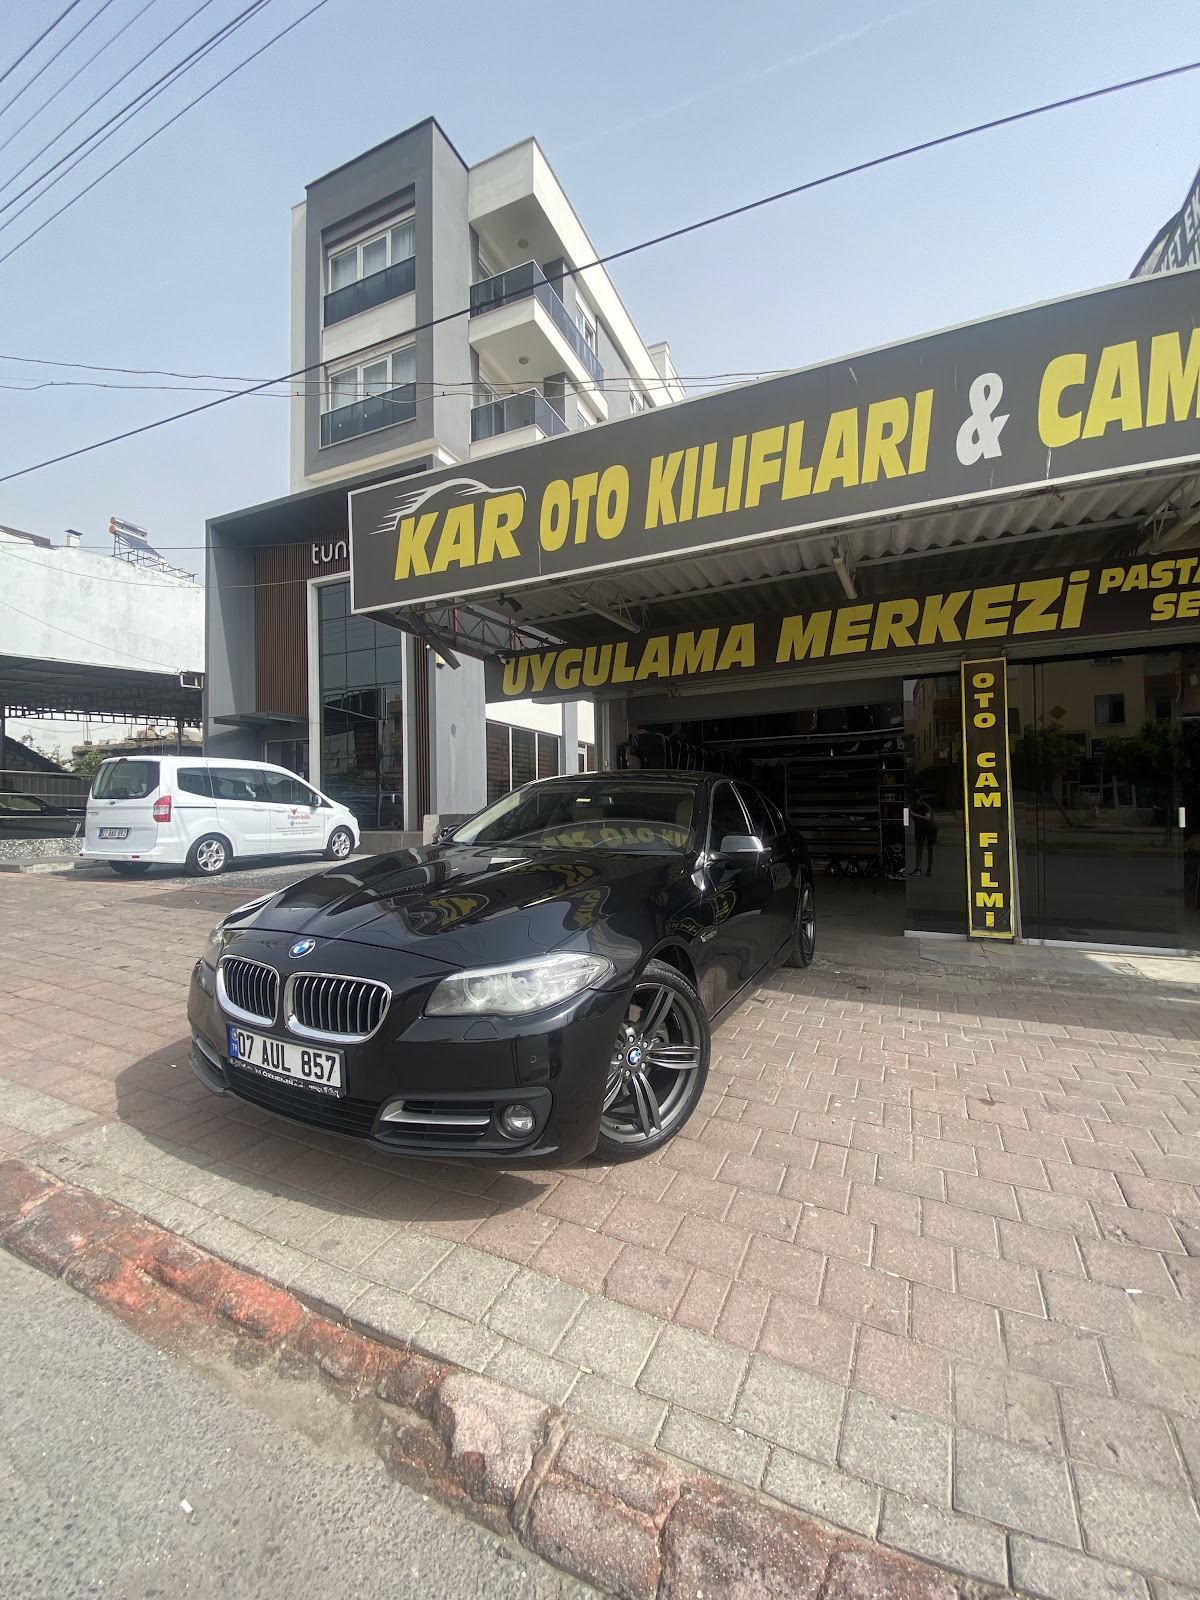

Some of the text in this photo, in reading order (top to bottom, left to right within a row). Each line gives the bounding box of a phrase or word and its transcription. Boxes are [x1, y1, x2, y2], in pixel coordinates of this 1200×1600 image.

[395, 326, 1200, 580] KAR OTO KILIFLARI & CAM
[312, 541, 350, 564] tun
[502, 623, 755, 696] UYGULAMA
[972, 672, 996, 728] OTO
[973, 752, 1001, 807] CAM
[238, 1032, 254, 1059] 07
[262, 1040, 291, 1073] AUL
[301, 1050, 336, 1082] 857
